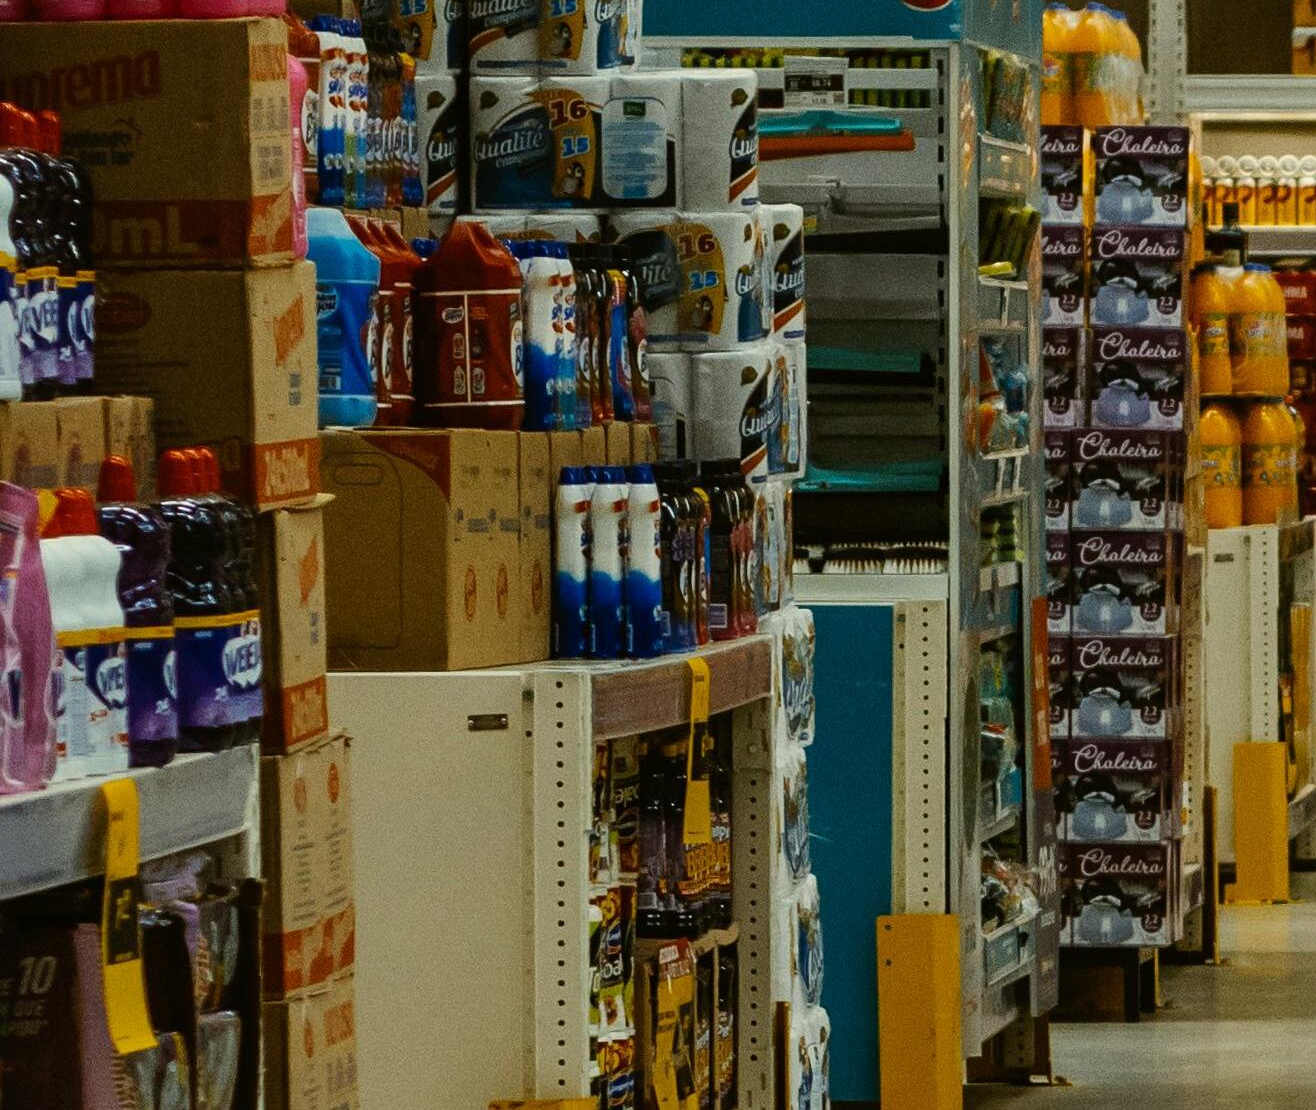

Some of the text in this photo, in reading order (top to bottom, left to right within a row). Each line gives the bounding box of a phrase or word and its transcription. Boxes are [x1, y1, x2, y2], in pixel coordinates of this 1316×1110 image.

[1100, 127, 1185, 158] Chaleira
[676, 231, 717, 262] 16
[1097, 229, 1181, 259] Chaleira
[686, 270, 720, 292] 15
[1076, 431, 1164, 460] Chaleira
[1078, 640, 1164, 669] Chaleira
[1080, 847, 1165, 878] Chaleira
